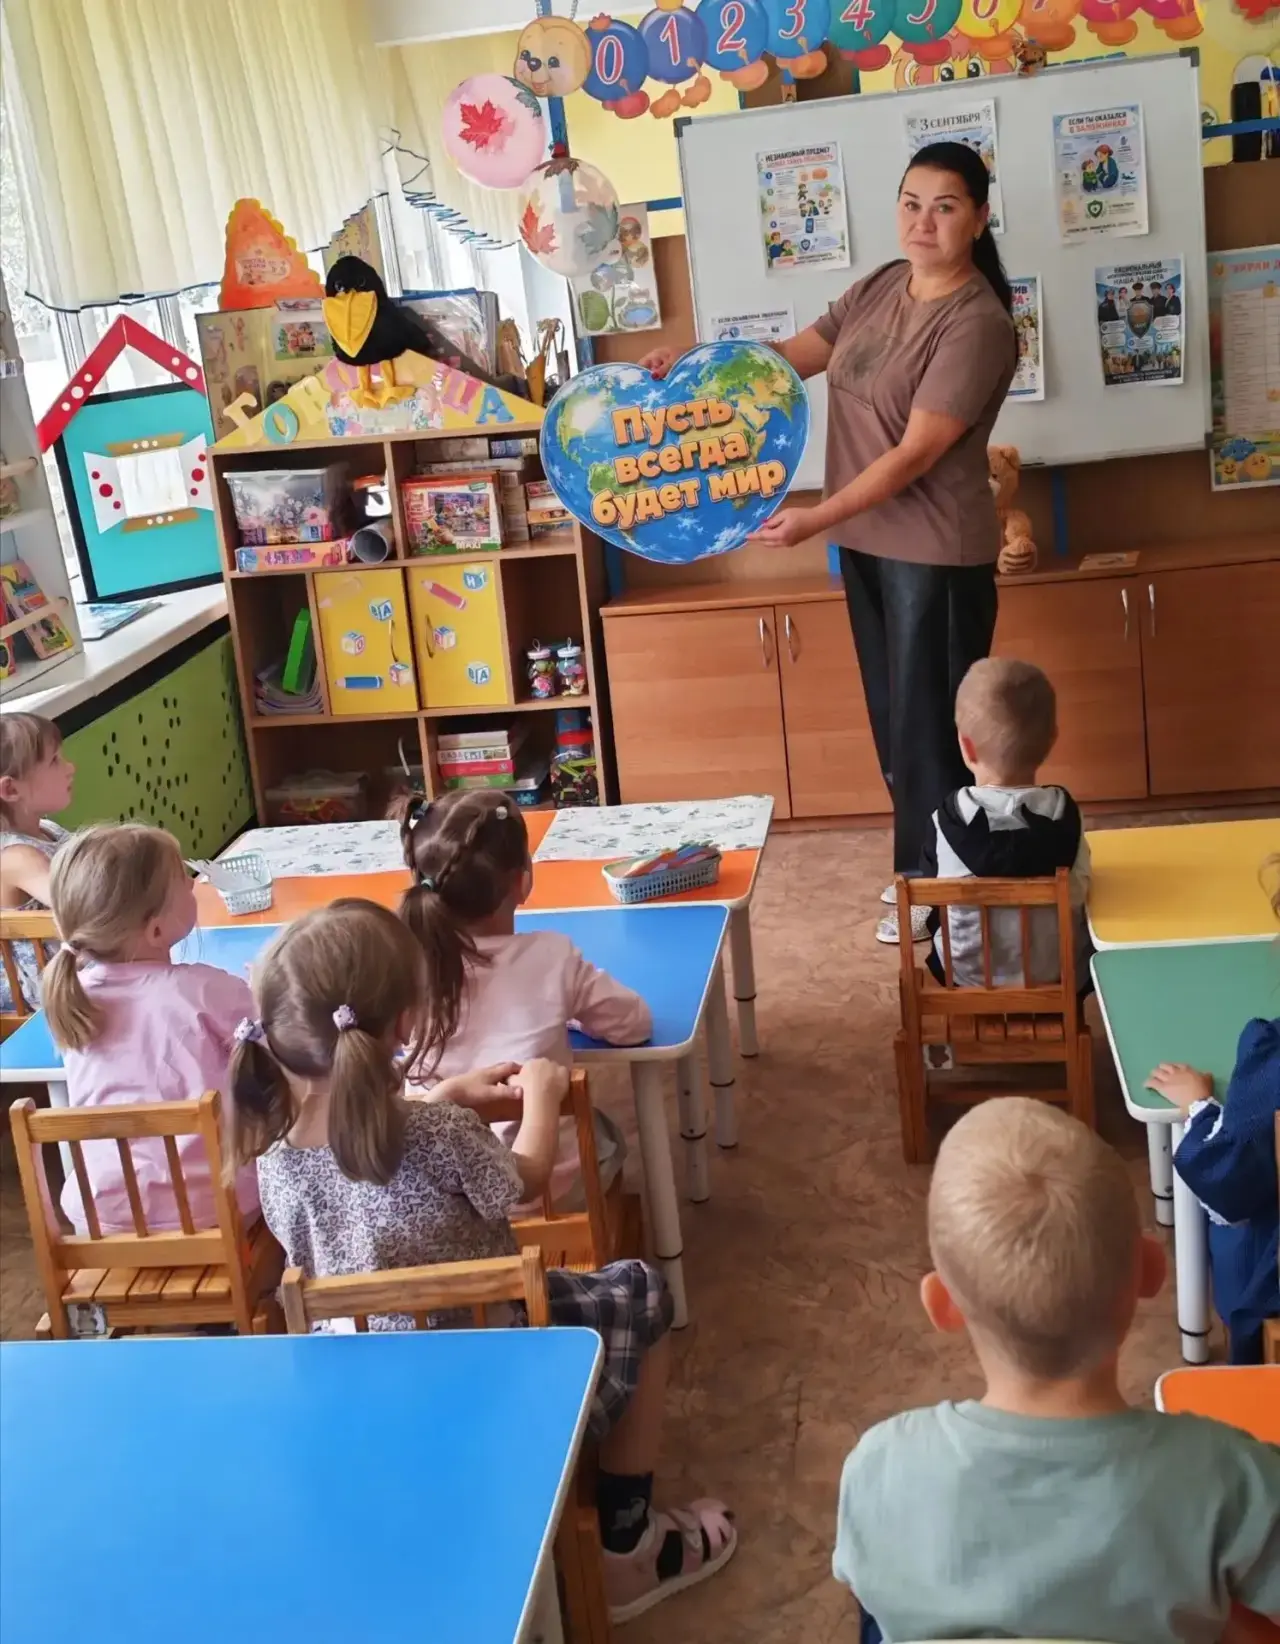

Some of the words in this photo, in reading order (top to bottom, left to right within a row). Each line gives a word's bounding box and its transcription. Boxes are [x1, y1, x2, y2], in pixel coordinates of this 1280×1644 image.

[596, 35, 624, 84] 0
[660, 15, 681, 66] 1
[717, 1, 747, 54] 2
[920, 117, 929, 131] 3
[930, 112, 981, 129] СЕНТЯБРЯ
[611, 397, 735, 447] Пусть
[613, 431, 749, 485] всегда
[591, 478, 700, 530] будет
[708, 459, 787, 503] мир
